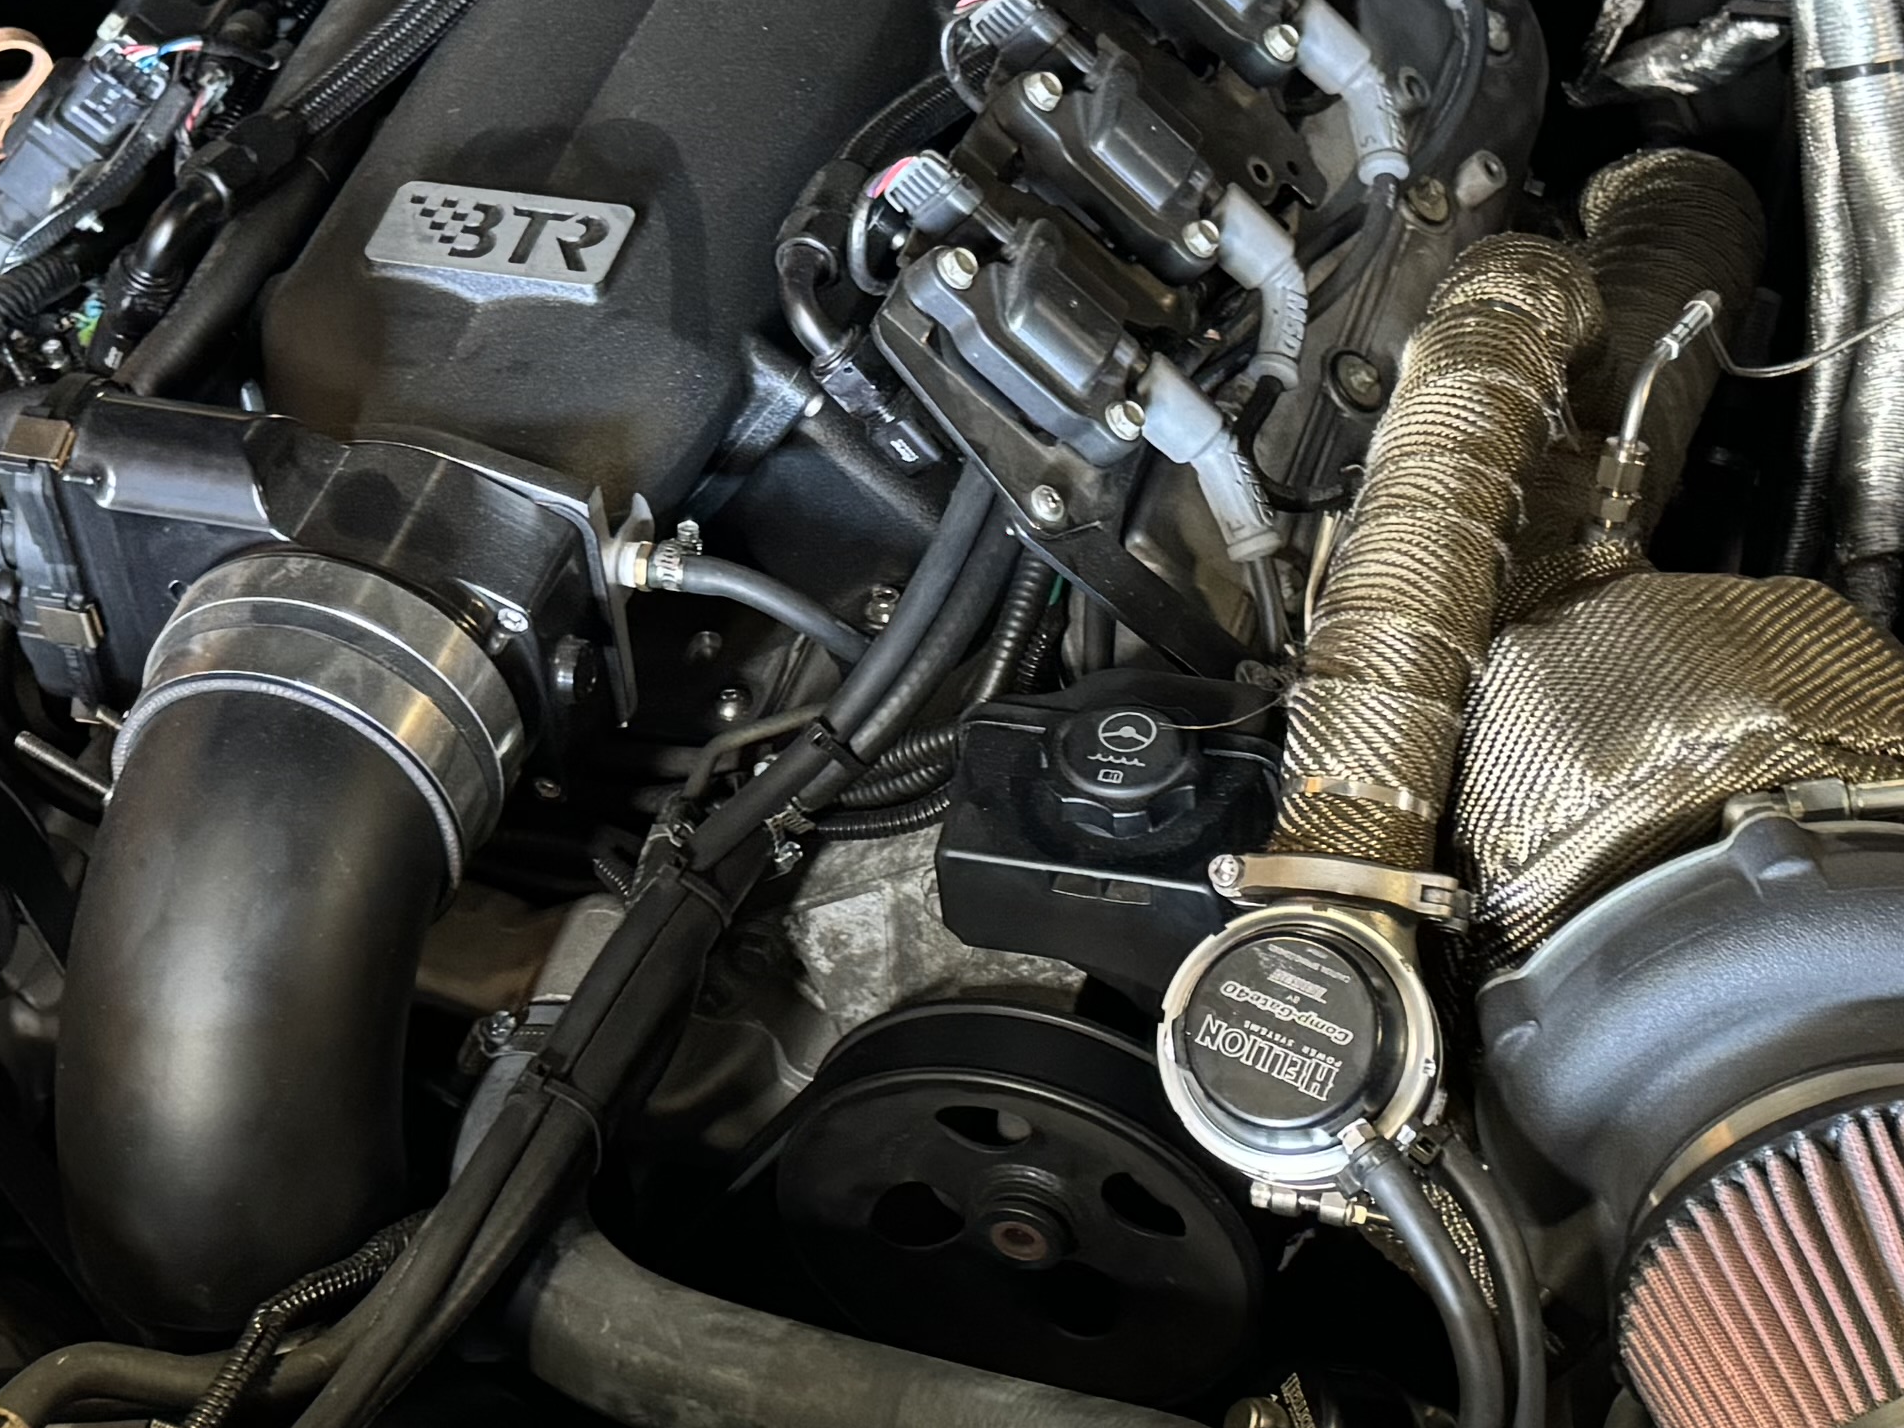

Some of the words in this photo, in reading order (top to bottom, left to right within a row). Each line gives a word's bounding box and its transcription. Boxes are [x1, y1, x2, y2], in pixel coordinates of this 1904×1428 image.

[448, 203, 610, 272] BTR
[1194, 1012, 1339, 1101] HELLION
[1242, 1019, 1295, 1046] SYSTEMS
[1300, 1045, 1343, 1067] POWER
